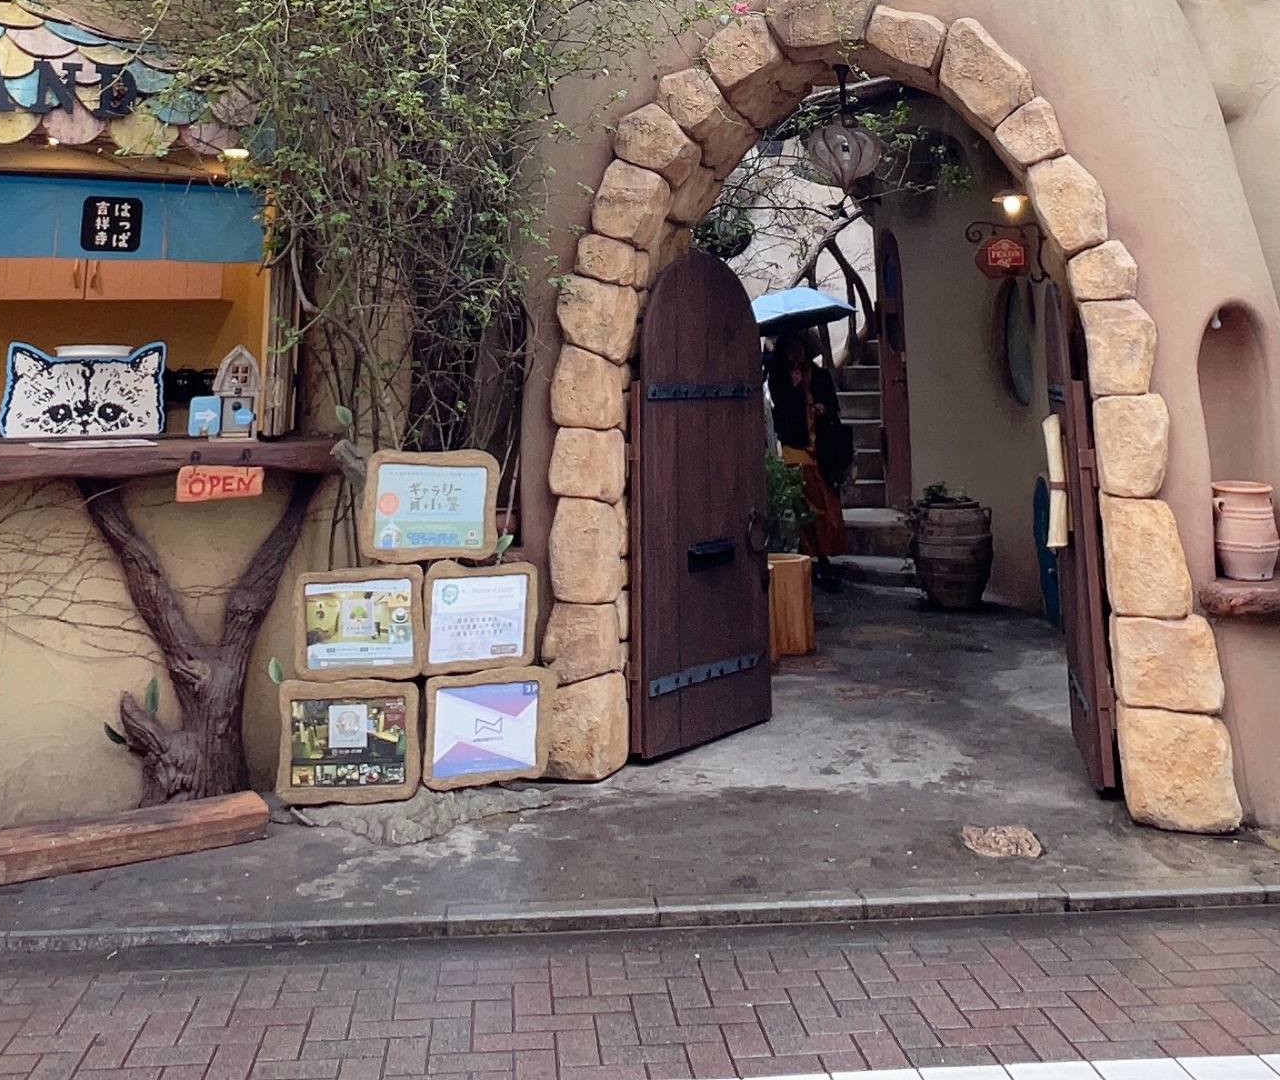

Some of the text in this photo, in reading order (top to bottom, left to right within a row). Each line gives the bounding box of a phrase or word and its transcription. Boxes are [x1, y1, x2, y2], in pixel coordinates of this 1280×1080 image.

[95, 201, 110, 246] 吉祥寺
[112, 202, 132, 248] はっぱ
